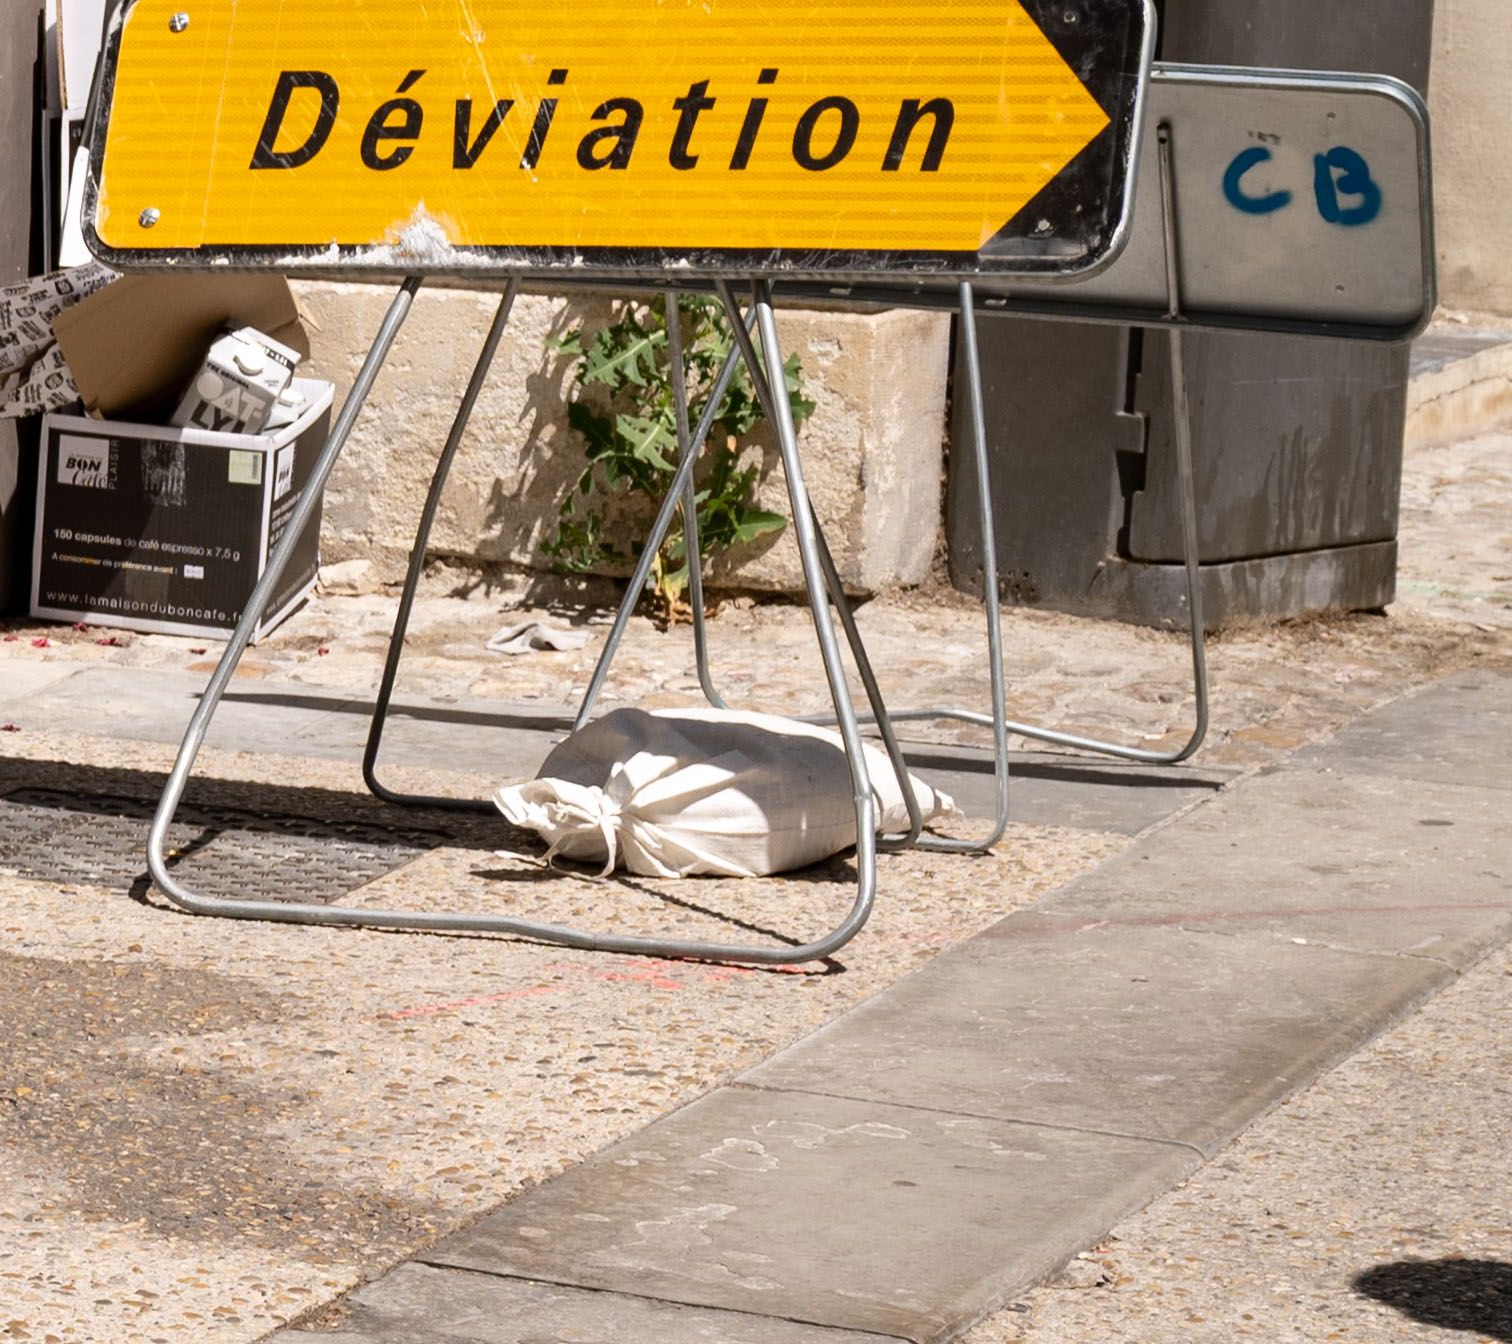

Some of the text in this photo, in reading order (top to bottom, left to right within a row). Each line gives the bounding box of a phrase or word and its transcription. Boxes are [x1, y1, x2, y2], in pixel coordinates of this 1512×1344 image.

[248, 68, 956, 173] Déviation
[66, 457, 102, 472] BON
[53, 528, 73, 540] 150
[74, 532, 122, 546] capsules
[124, 537, 137, 548] de
[138, 538, 160, 551] café
[161, 542, 205, 555] espresso
[206, 548, 213, 557] x
[232, 551, 241, 562] g
